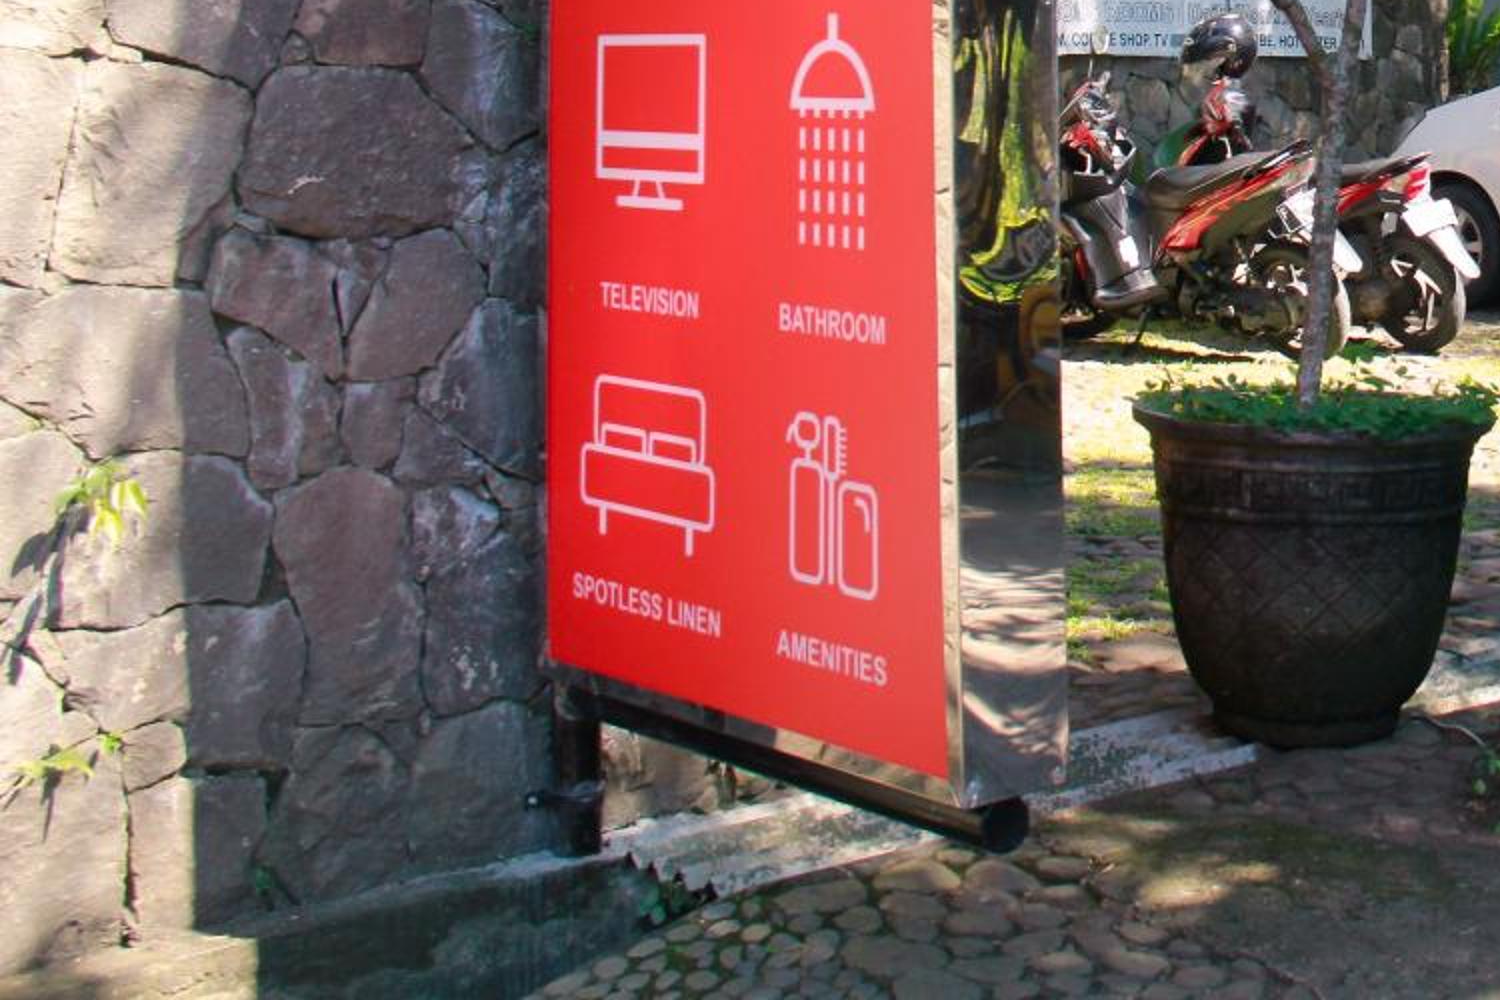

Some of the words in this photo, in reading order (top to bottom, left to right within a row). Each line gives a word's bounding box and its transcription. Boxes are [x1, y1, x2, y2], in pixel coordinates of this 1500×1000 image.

[600, 281, 700, 319] TELEVISION
[778, 302, 887, 346] BATHROOM
[571, 571, 664, 622] SPOTLESS
[667, 598, 722, 639] LINEN
[775, 629, 889, 688] AMENITIES
